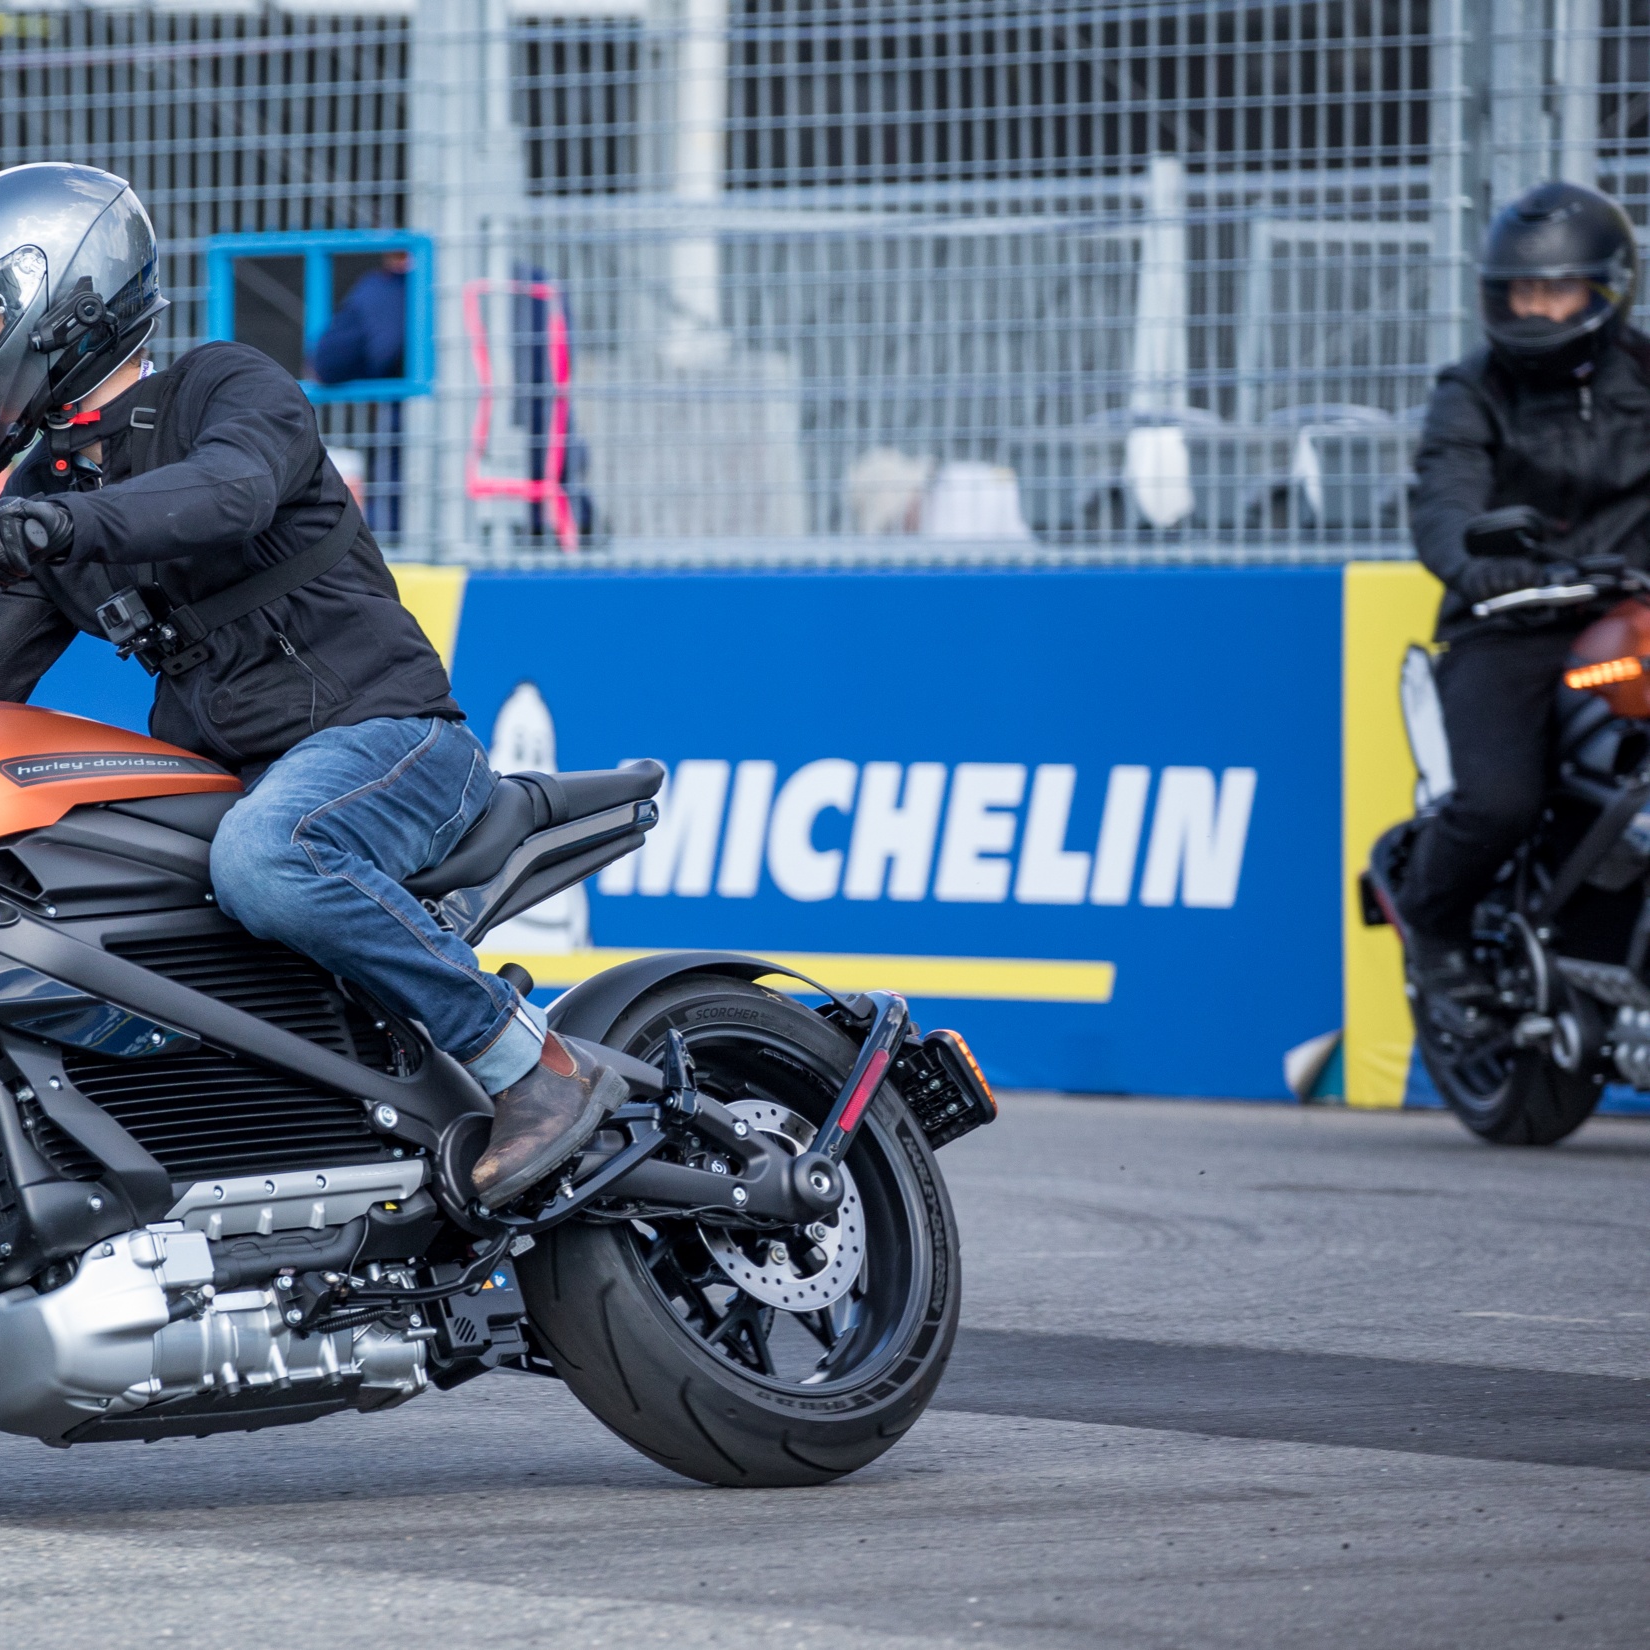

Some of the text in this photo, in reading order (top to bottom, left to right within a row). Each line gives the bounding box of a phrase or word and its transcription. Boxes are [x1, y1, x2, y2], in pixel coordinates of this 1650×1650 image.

[17, 758, 180, 776] harley-davidson
[597, 757, 1257, 909] MICHELIN
[695, 1007, 759, 1021] SCORCHER
